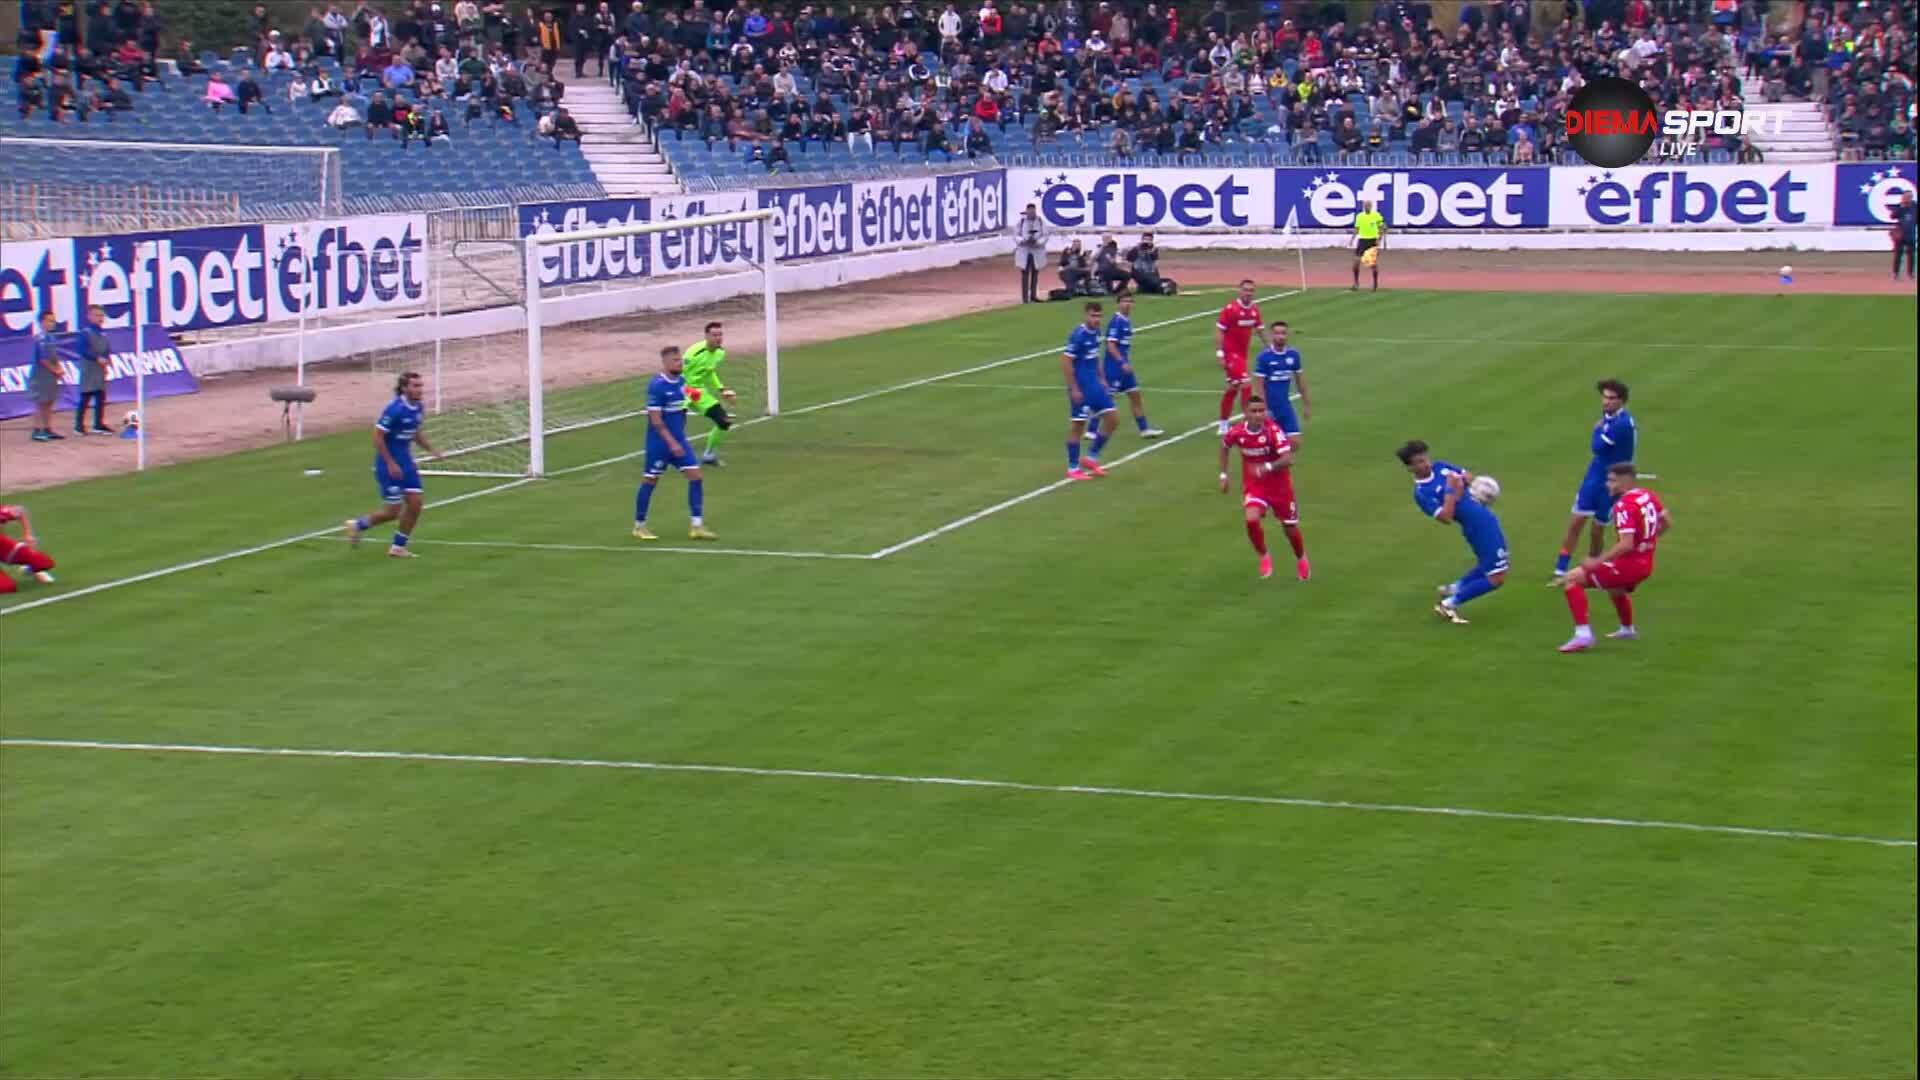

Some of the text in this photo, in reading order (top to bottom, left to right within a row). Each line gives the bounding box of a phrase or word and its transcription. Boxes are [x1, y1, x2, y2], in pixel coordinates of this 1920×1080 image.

[772, 190, 847, 258] efbet
[861, 183, 932, 247] efbet
[1041, 173, 1249, 228] efbet
[1310, 172, 1525, 228] efbet
[1586, 170, 1808, 226] efbet
[538, 203, 643, 283] efbet
[660, 196, 755, 270] efbet
[88, 234, 264, 329] efbet
[278, 222, 423, 314] efbet
[1640, 502, 1657, 539] 19
